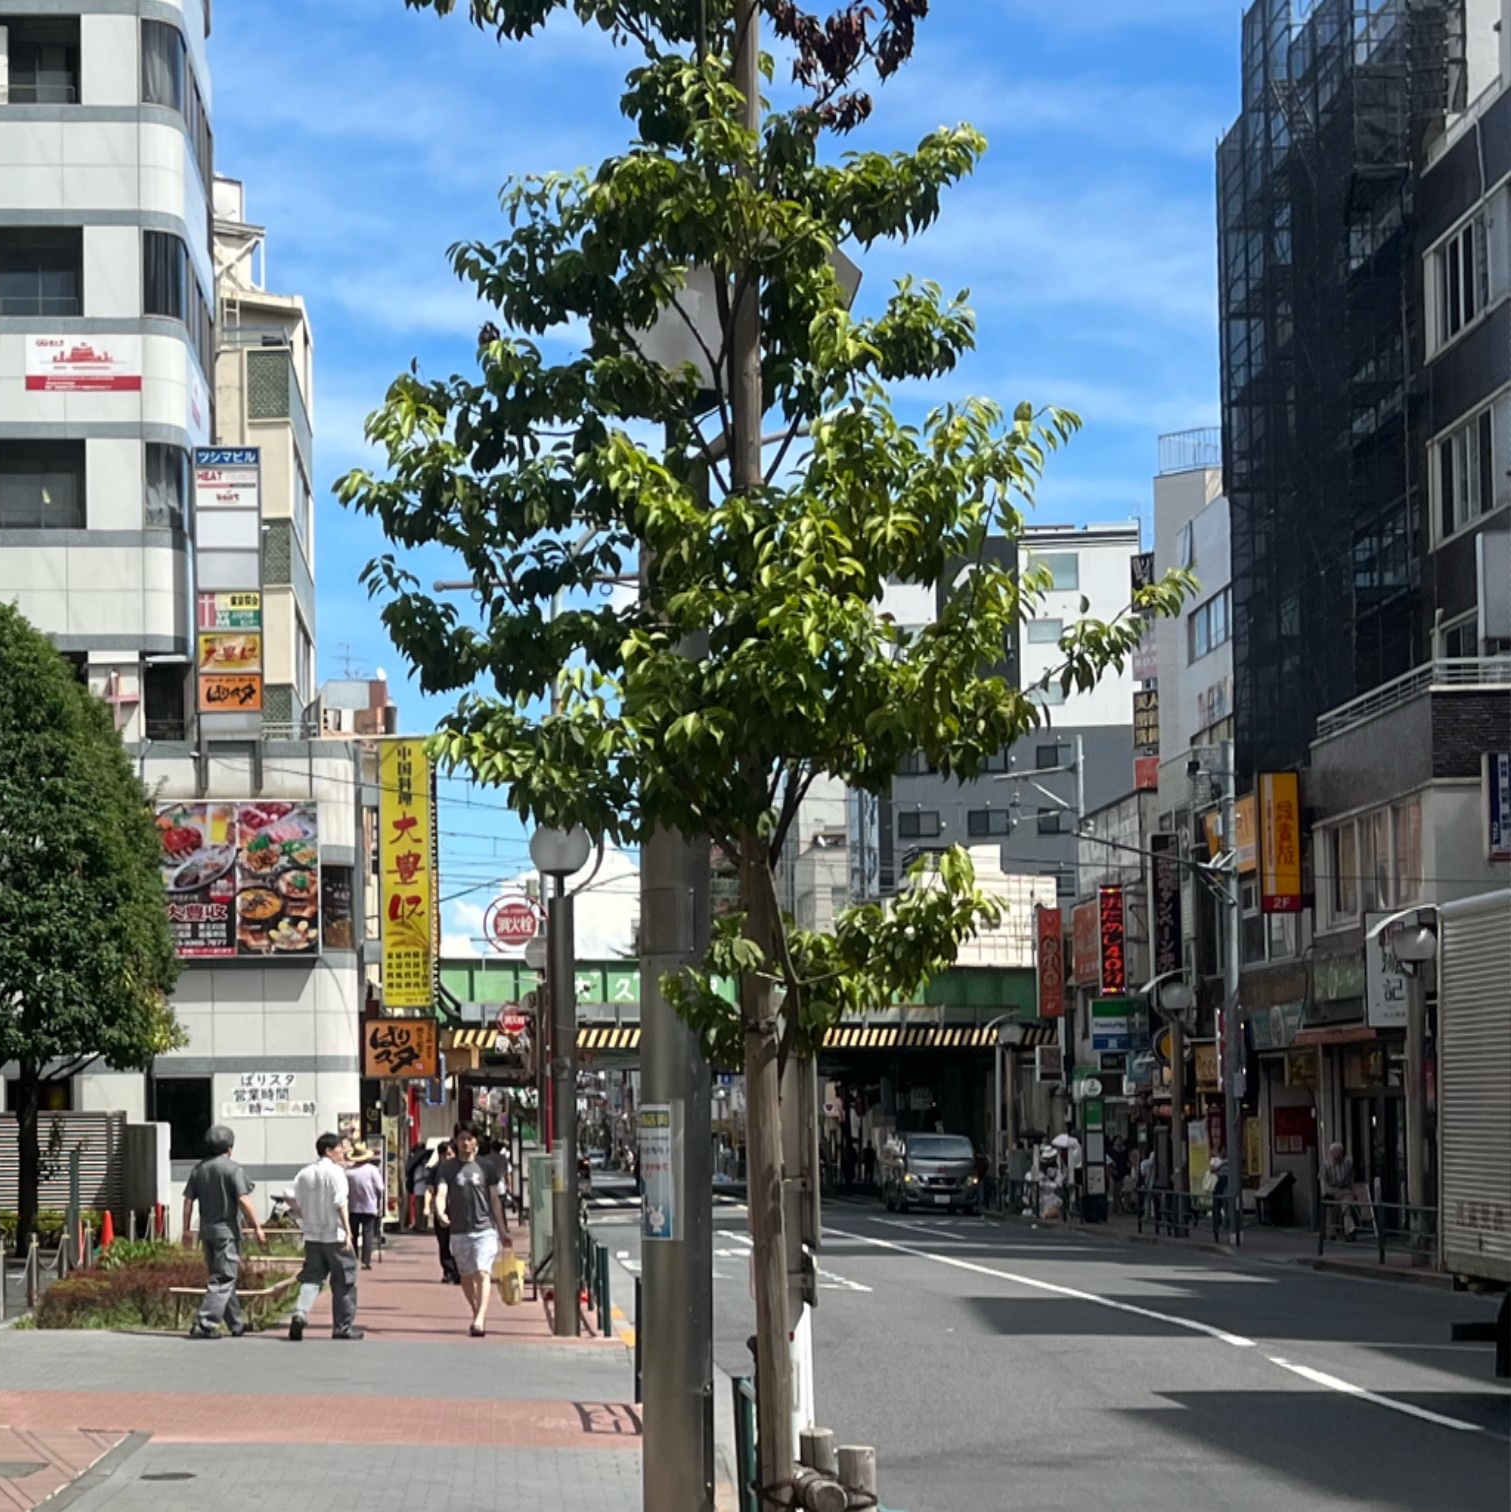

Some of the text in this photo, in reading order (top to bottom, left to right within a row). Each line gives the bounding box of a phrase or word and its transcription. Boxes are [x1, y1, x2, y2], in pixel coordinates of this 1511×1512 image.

[197, 451, 256, 464] ツシマビル
[1273, 897, 1291, 909] 2F
[497, 915, 534, 934] 消火栓
[233, 1088, 290, 1102] 営業時間
